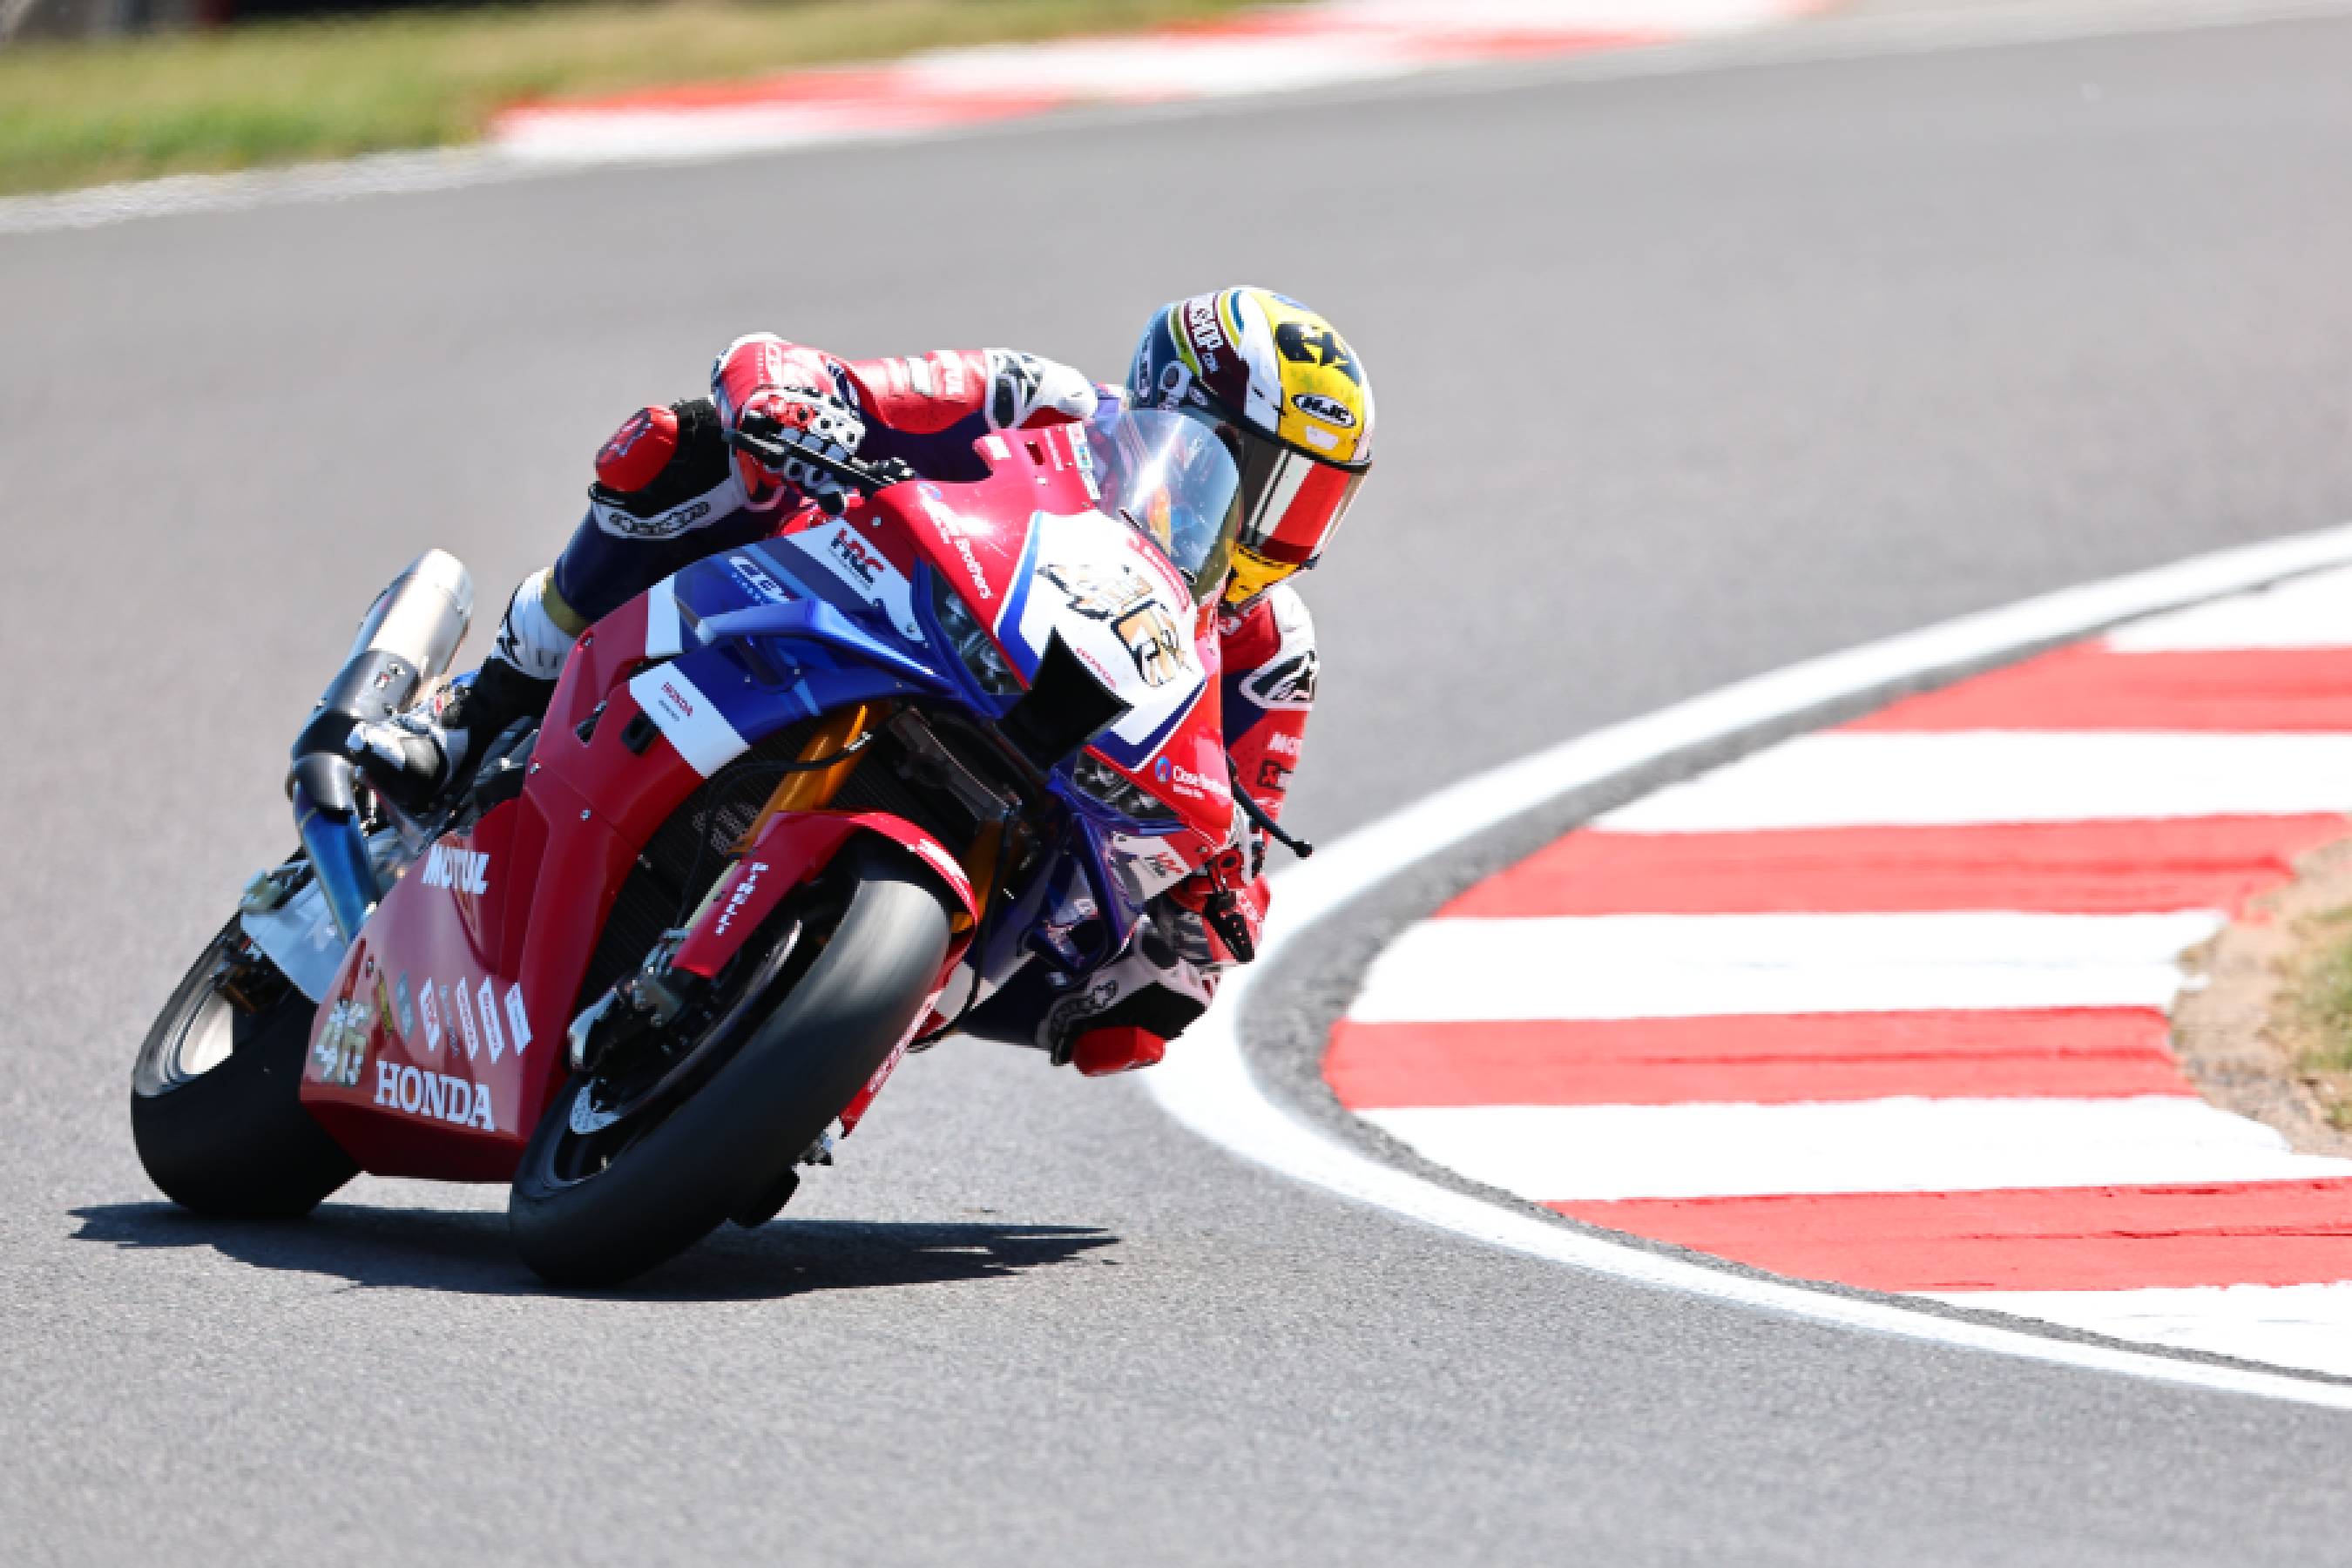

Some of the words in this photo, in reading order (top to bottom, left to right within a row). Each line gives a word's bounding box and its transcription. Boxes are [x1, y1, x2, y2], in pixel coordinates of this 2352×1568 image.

[1303, 395, 1350, 423] HJC
[830, 526, 885, 584] HRC
[1076, 646, 1118, 687] HONDA
[422, 843, 490, 895] MOTUL
[373, 1059, 495, 1132] HONDA
